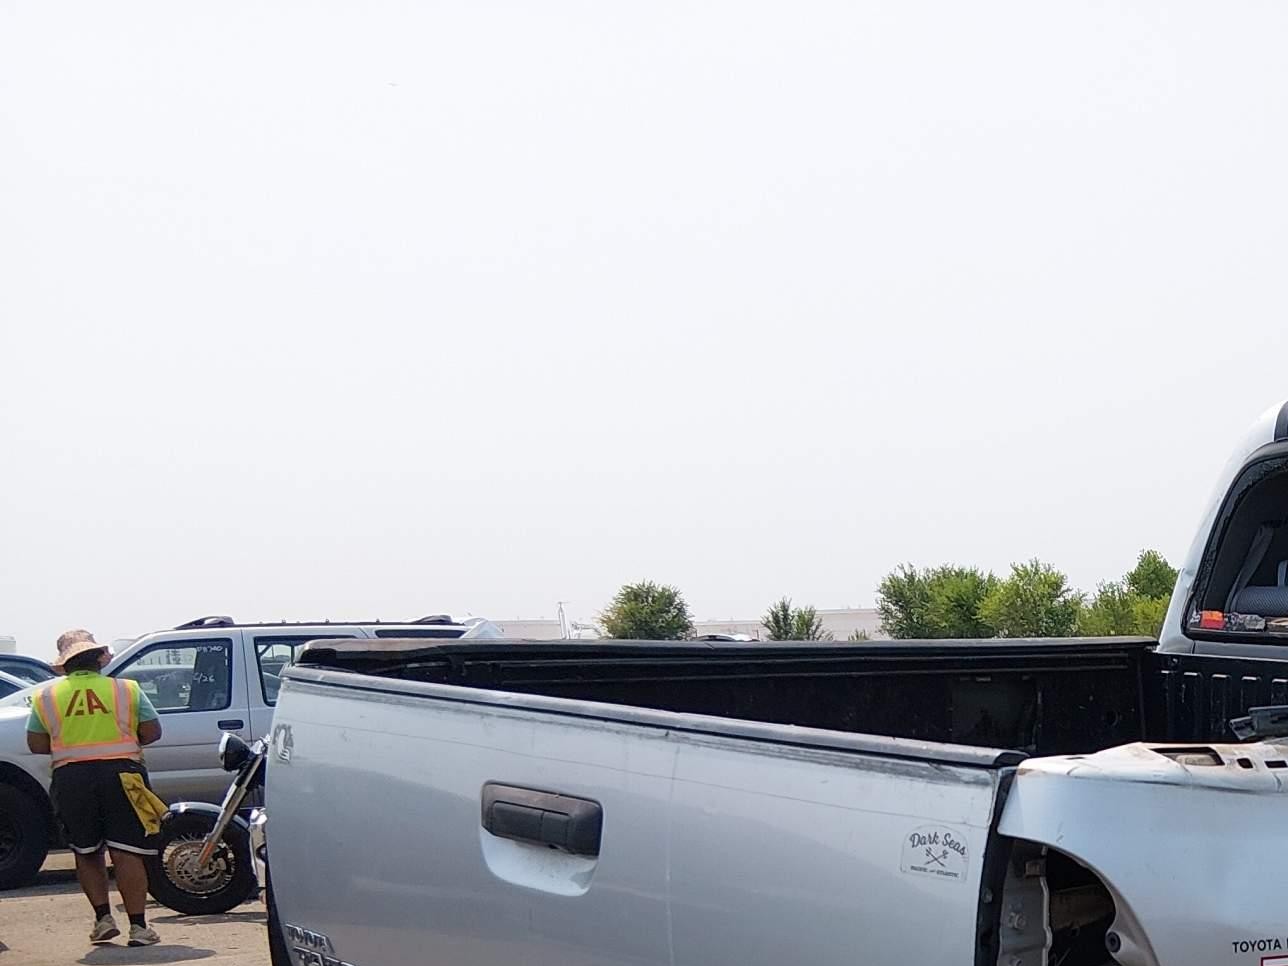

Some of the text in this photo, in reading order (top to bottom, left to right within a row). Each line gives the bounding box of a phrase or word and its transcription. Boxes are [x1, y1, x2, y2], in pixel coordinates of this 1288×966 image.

[909, 831, 966, 856] Dark Seas
[1232, 938, 1282, 953] TOYOTA
